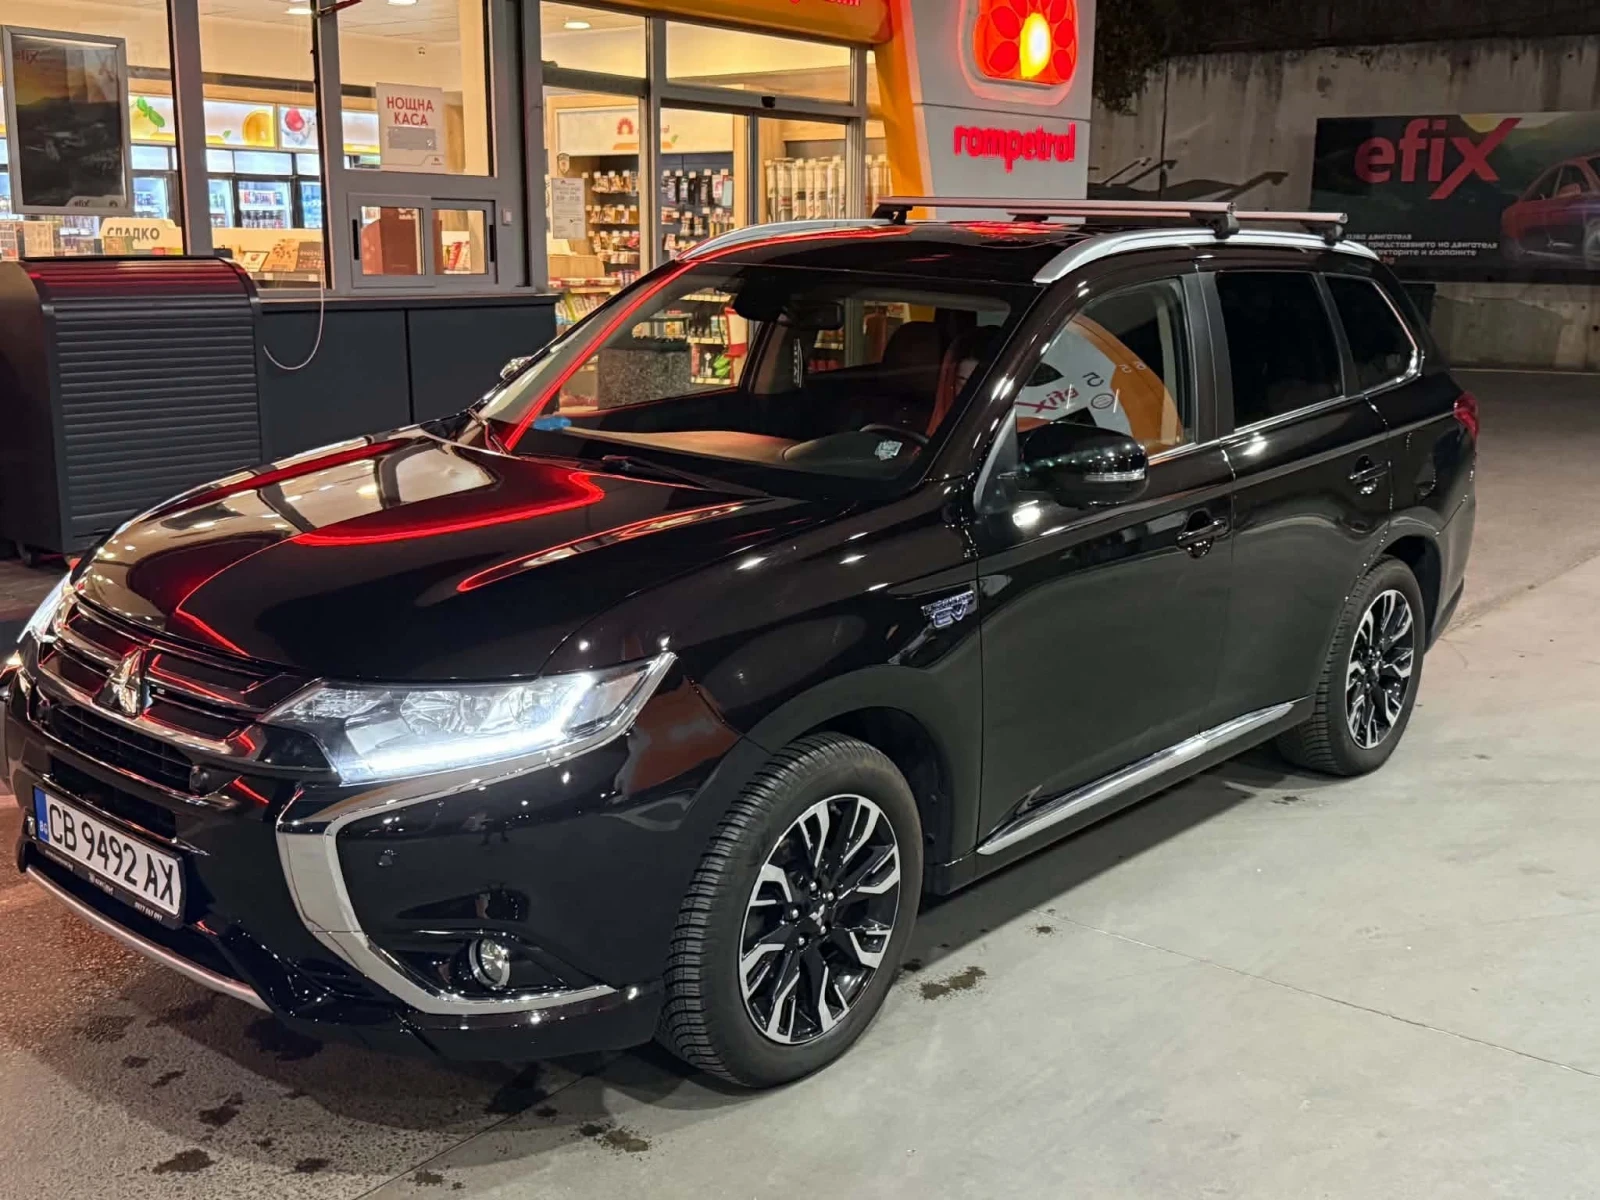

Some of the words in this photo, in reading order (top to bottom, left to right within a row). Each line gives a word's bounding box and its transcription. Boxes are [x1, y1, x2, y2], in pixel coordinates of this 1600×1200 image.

[386, 96, 434, 112] НОЩНА
[394, 112, 428, 126] КАСА
[953, 122, 1076, 173] rompetrol
[1354, 117, 1523, 200] efix
[49, 803, 77, 853] CB
[81, 821, 138, 888] 9492
[143, 853, 174, 906] AX
